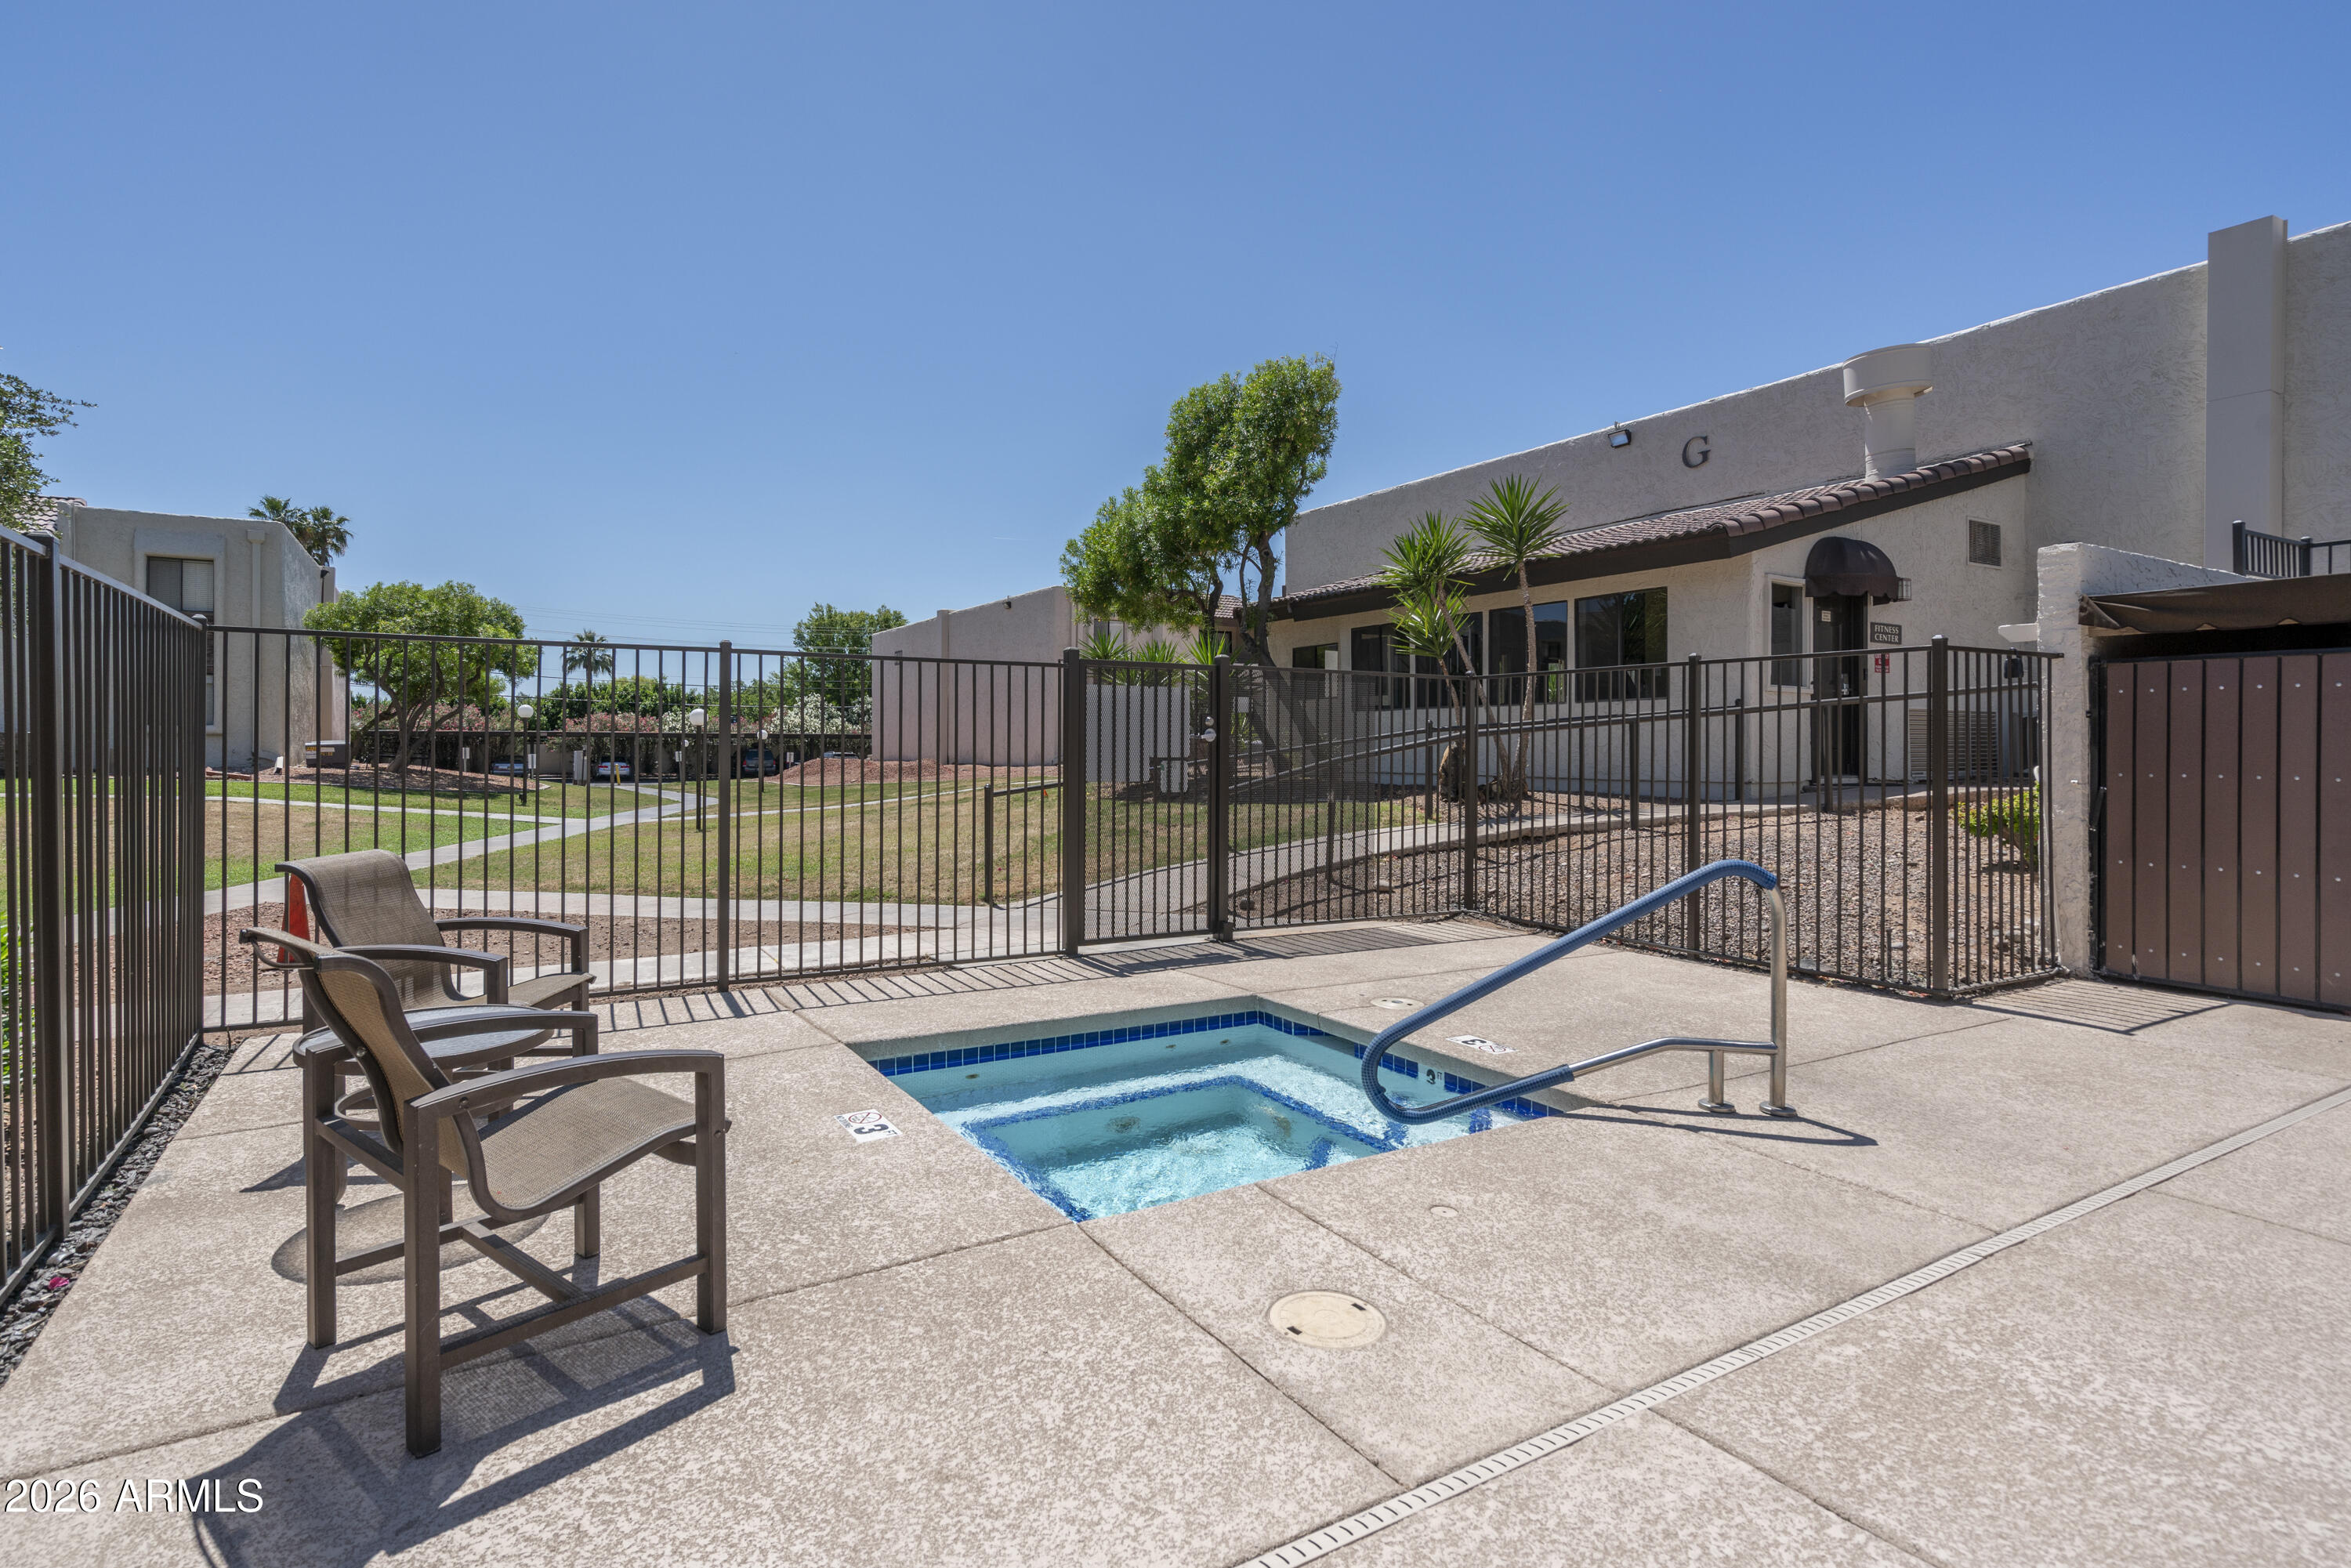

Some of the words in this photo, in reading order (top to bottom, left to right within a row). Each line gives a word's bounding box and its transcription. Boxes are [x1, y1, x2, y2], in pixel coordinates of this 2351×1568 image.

[1682, 436, 1712, 468] G
[1875, 625, 1900, 634] FITNESS
[1875, 633, 1899, 643] CENTER
[1426, 1069, 1436, 1085] 3
[853, 1124, 889, 1135] 3
